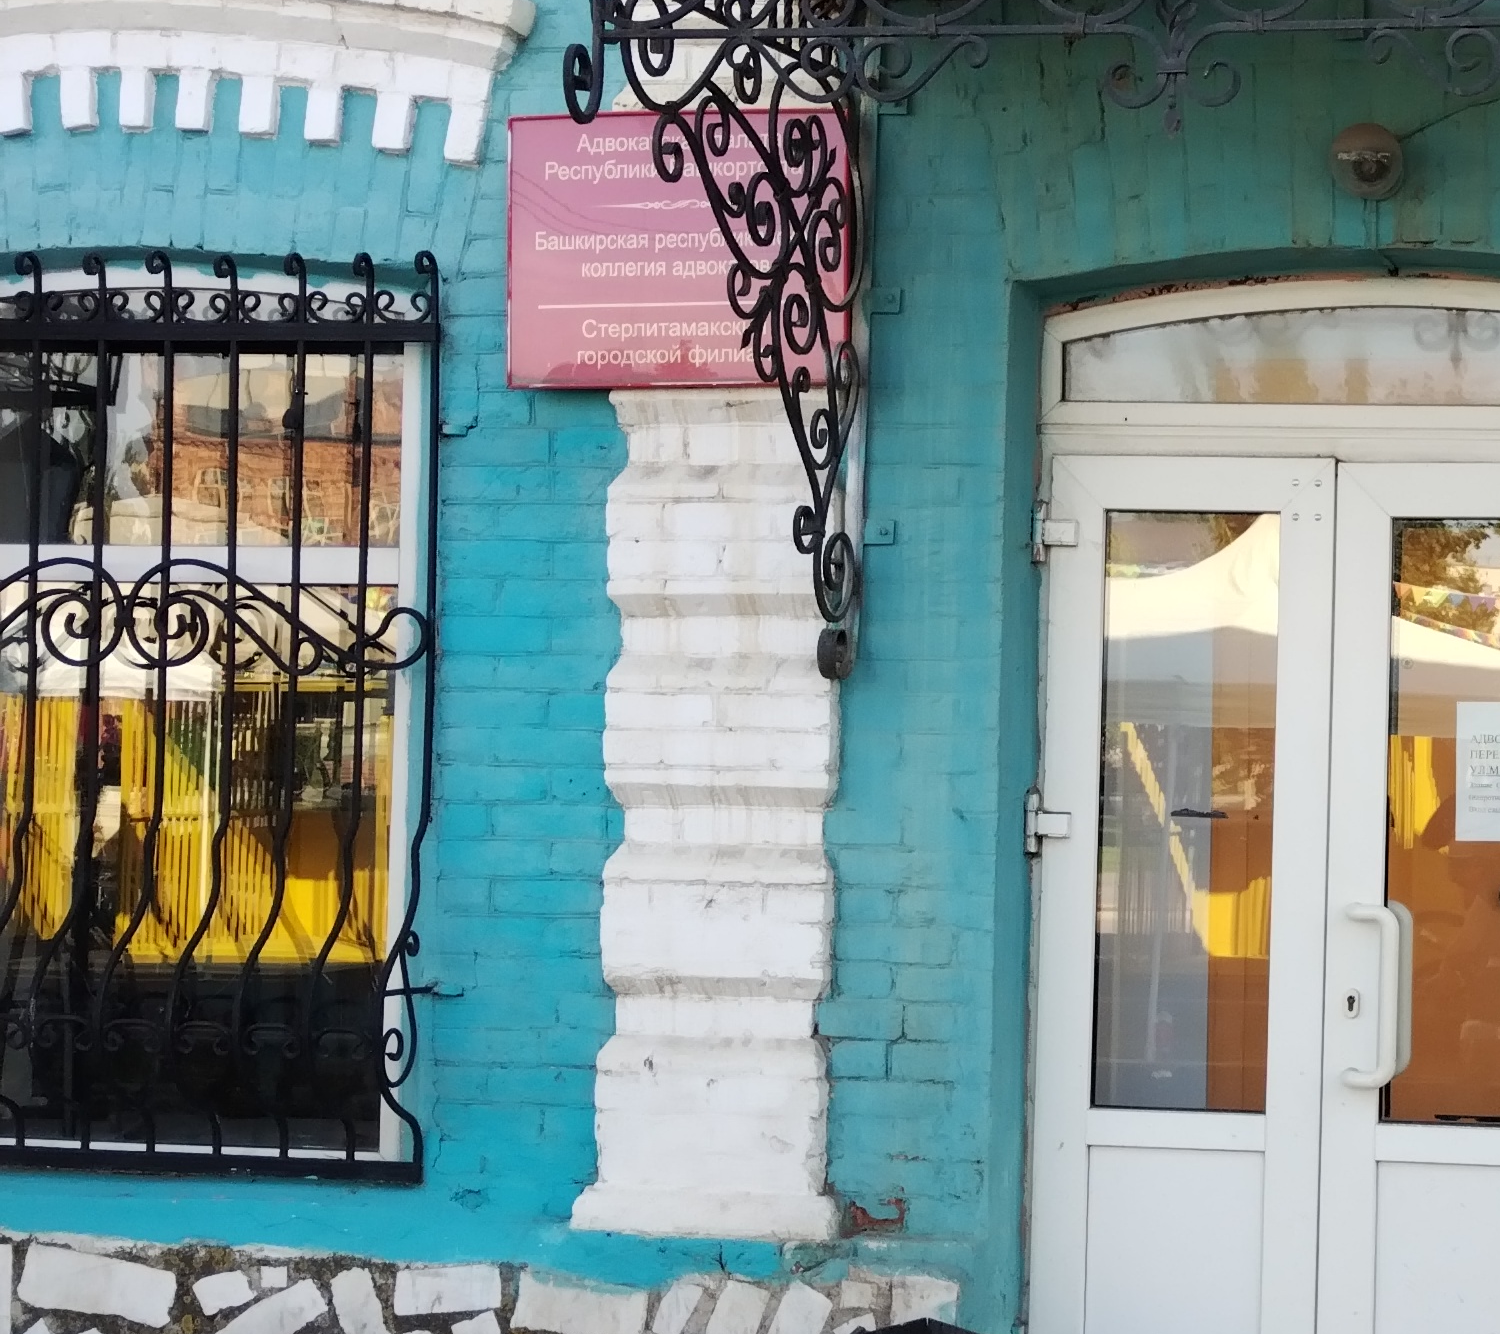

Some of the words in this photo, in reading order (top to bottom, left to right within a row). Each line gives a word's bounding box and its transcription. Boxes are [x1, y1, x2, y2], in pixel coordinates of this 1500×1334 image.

[577, 132, 705, 155] Адвокаа
[535, 230, 648, 254] Башкирская
[654, 226, 817, 254] респубик
[581, 260, 666, 278] коллегия
[672, 258, 771, 280] адвоков
[582, 317, 767, 341] Стерлитамакск
[577, 344, 680, 368] городской
[688, 343, 772, 367] филиа
